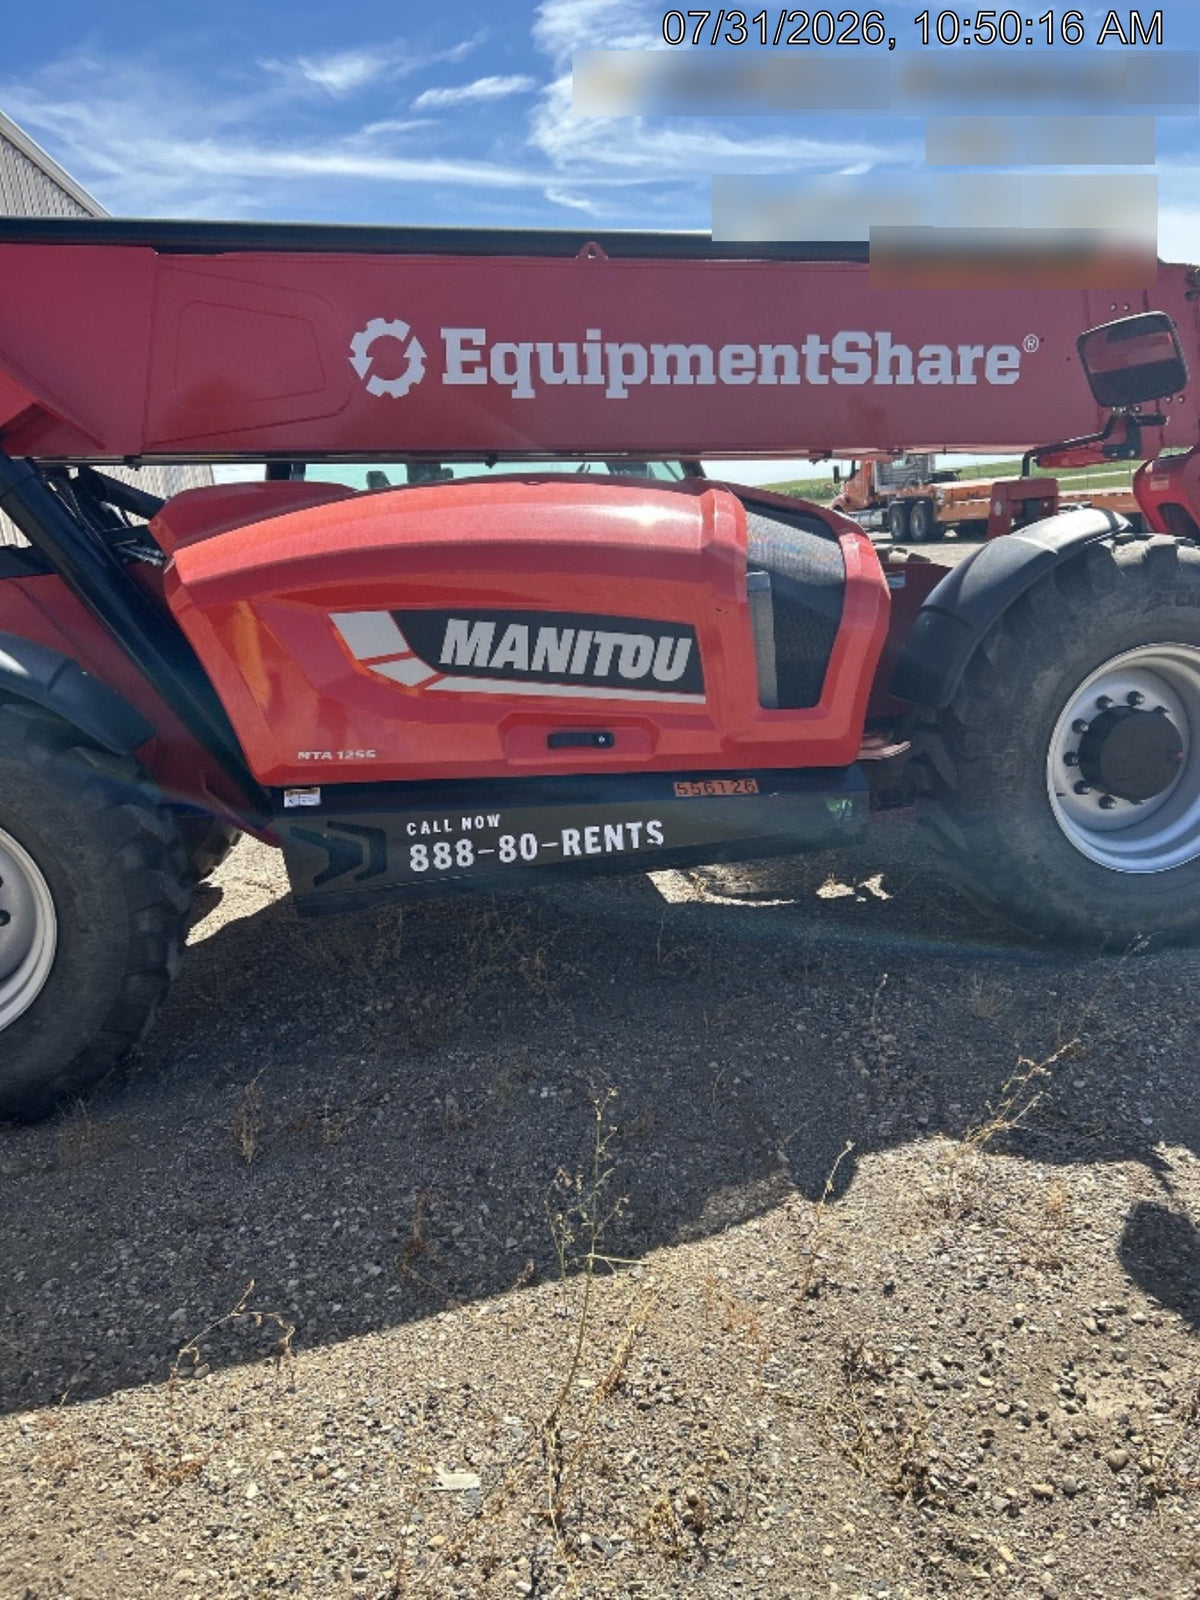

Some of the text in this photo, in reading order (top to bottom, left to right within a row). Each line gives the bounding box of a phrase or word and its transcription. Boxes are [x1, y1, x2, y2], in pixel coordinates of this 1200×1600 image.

[438, 617, 693, 682] MANITOU
[298, 751, 332, 760] MTA
[676, 780, 757, 796] 556126
[406, 813, 501, 837] CALL NOW
[409, 819, 665, 873] 888-80-RENTS
